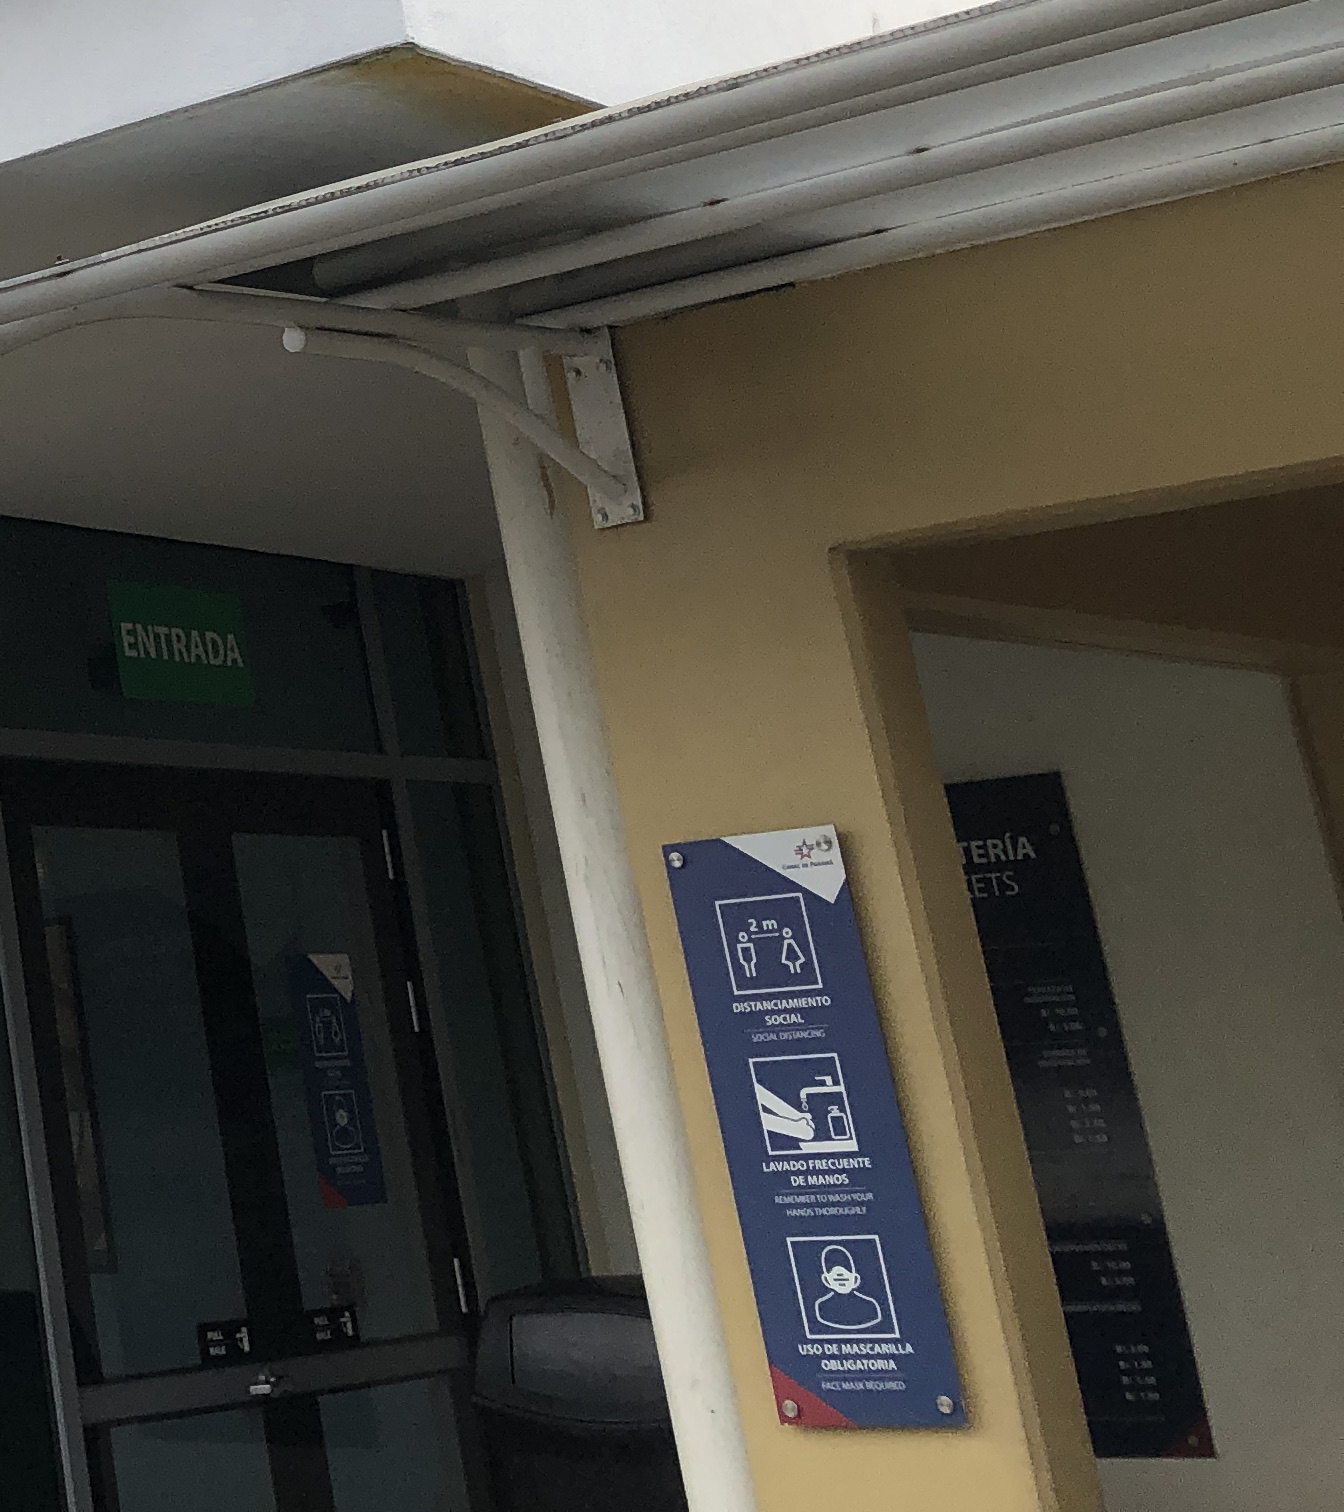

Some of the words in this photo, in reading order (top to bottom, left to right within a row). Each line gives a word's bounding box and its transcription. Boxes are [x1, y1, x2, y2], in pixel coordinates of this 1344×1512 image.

[120, 622, 244, 668] ENTRADA
[968, 871, 1019, 898] ETS
[747, 919, 758, 931] 2
[762, 919, 778, 930] m
[732, 995, 831, 1013] DISTANCIAMIENTO
[764, 1013, 805, 1026] SOCIAL
[762, 1160, 807, 1172] LAVADO
[808, 1157, 872, 1170] FRECUENTE
[790, 1175, 807, 1186] DE
[807, 1173, 850, 1186] MANOS
[797, 1344, 822, 1355] USO
[824, 1344, 840, 1355] DE
[841, 1342, 915, 1354] MASCARILLA
[820, 1359, 898, 1371] OBLIGATORIA
